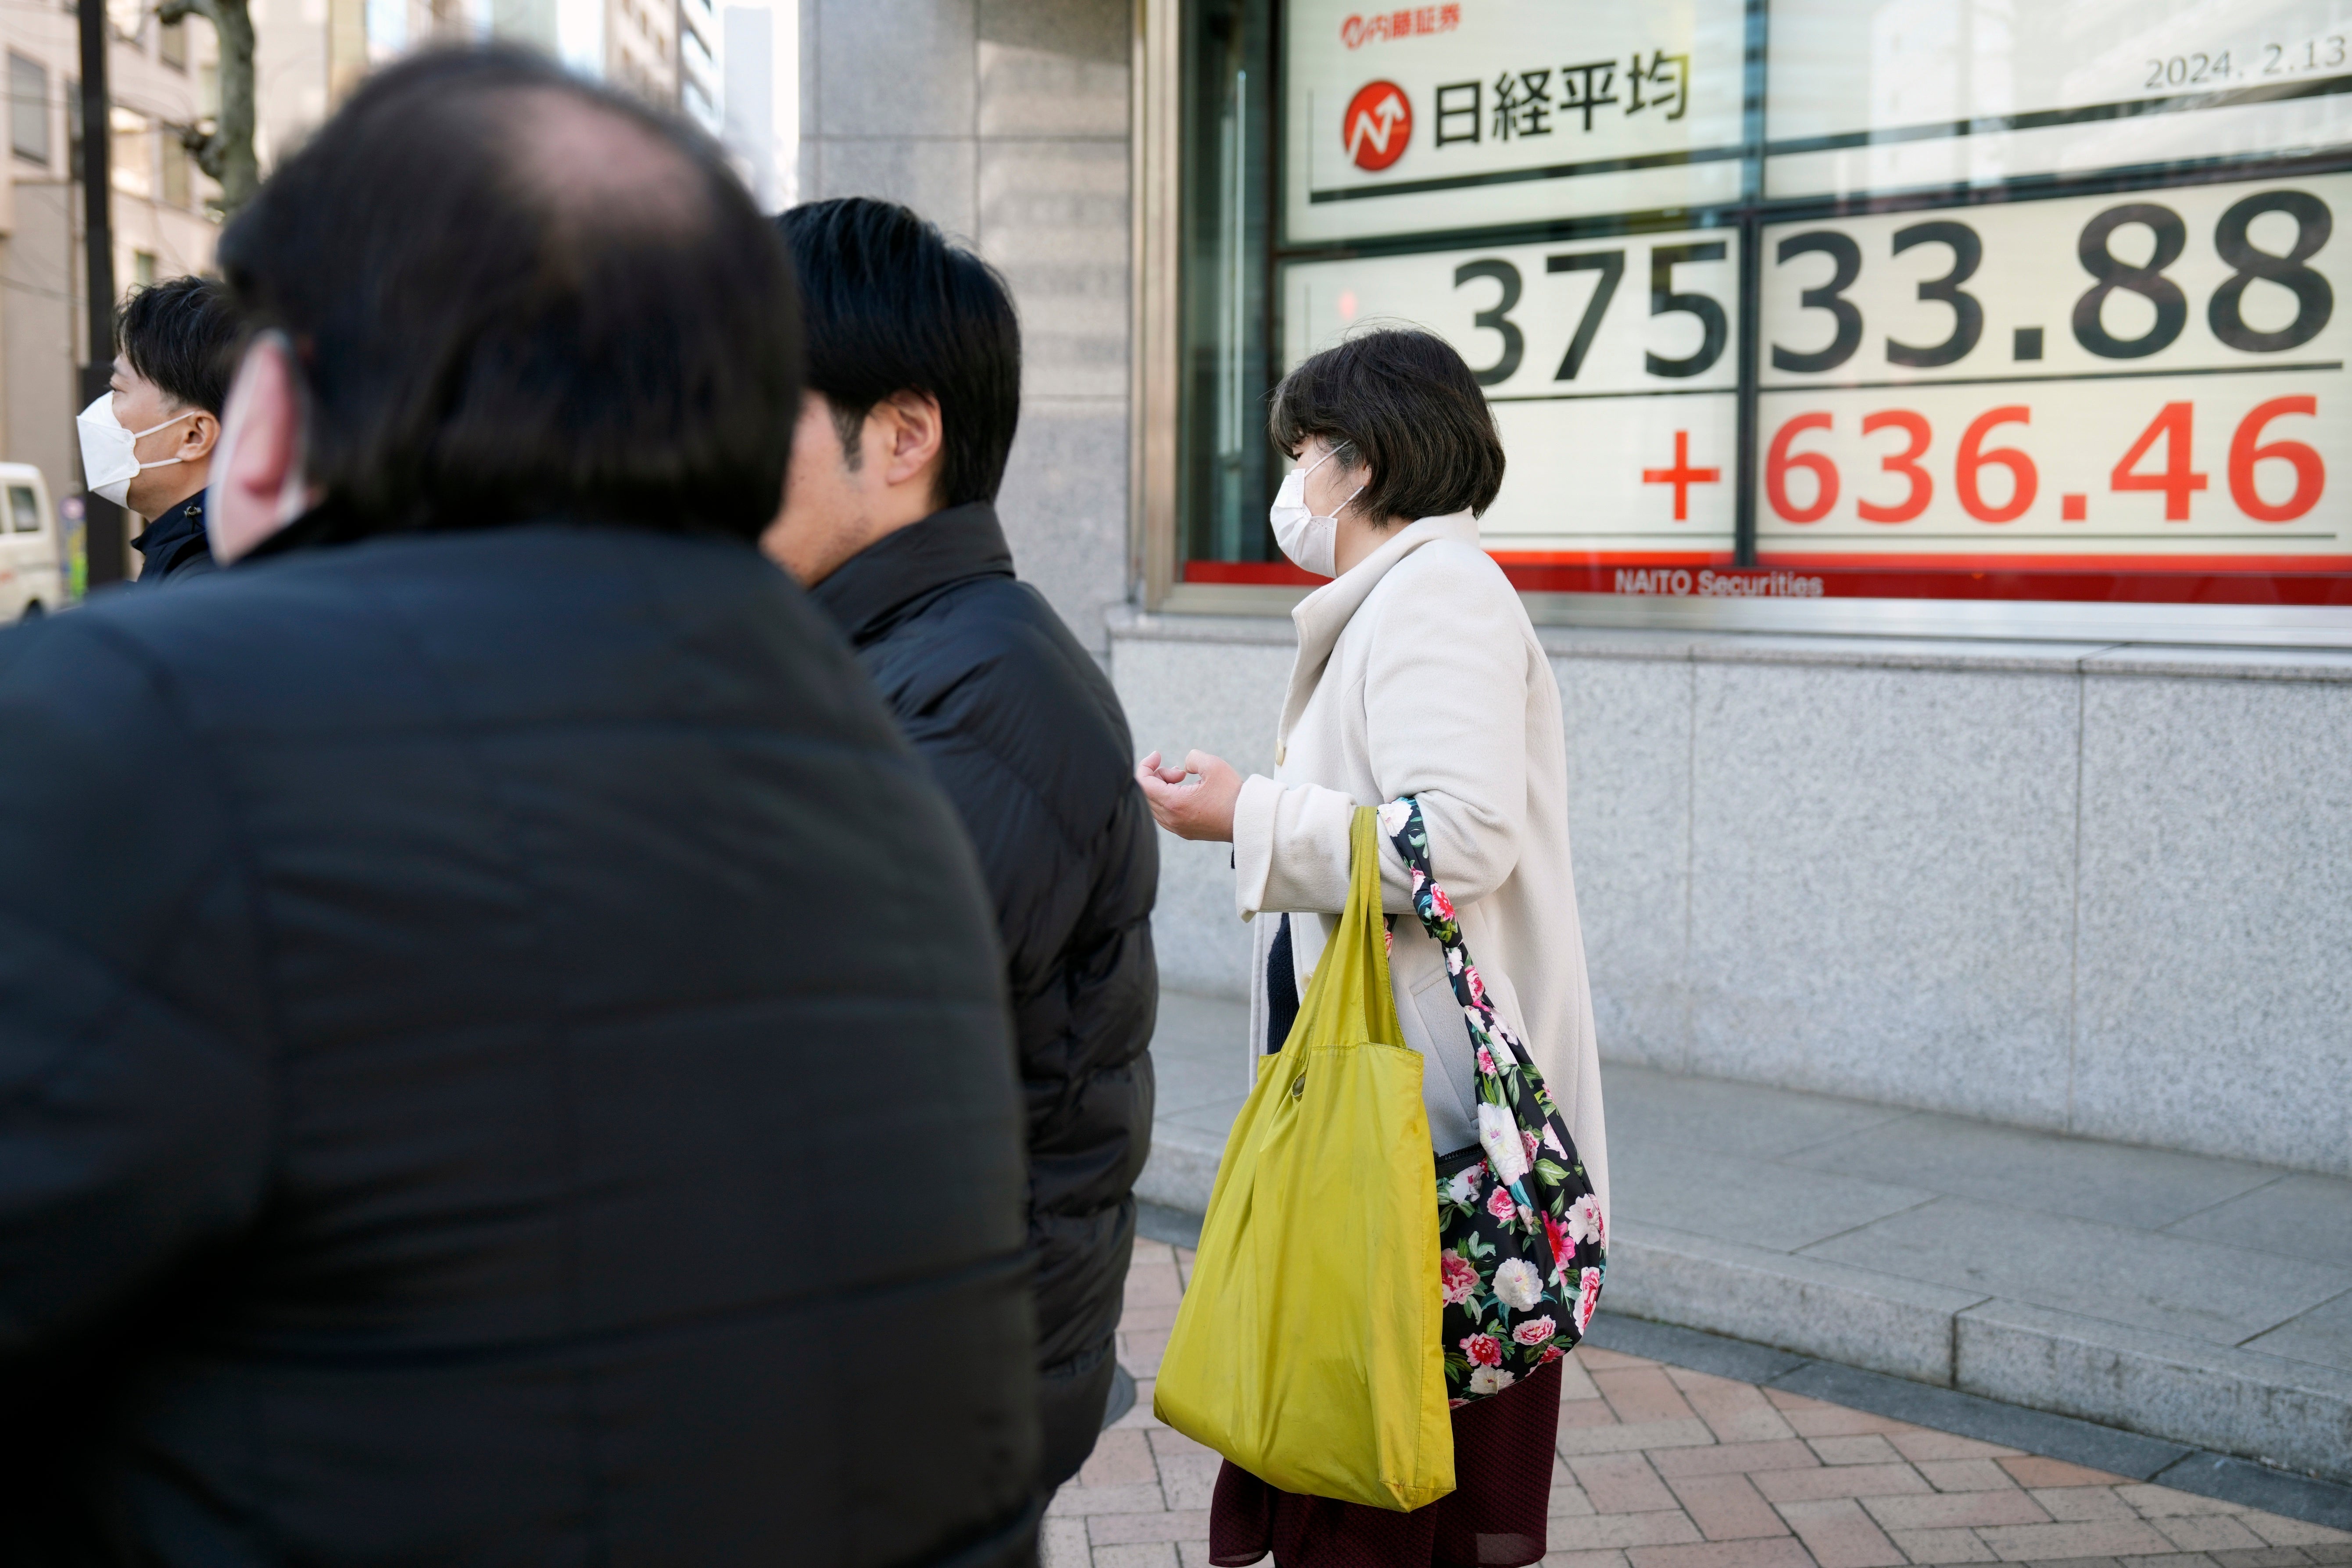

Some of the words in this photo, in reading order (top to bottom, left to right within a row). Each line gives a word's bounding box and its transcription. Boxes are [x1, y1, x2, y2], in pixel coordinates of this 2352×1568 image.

[2263, 35, 2346, 75] 2.13
[1434, 50, 1690, 148] 日経平均
[1453, 189, 2334, 387] 37533.88
[1615, 569, 1693, 596] NAITO
[1697, 569, 1825, 597] Securities
